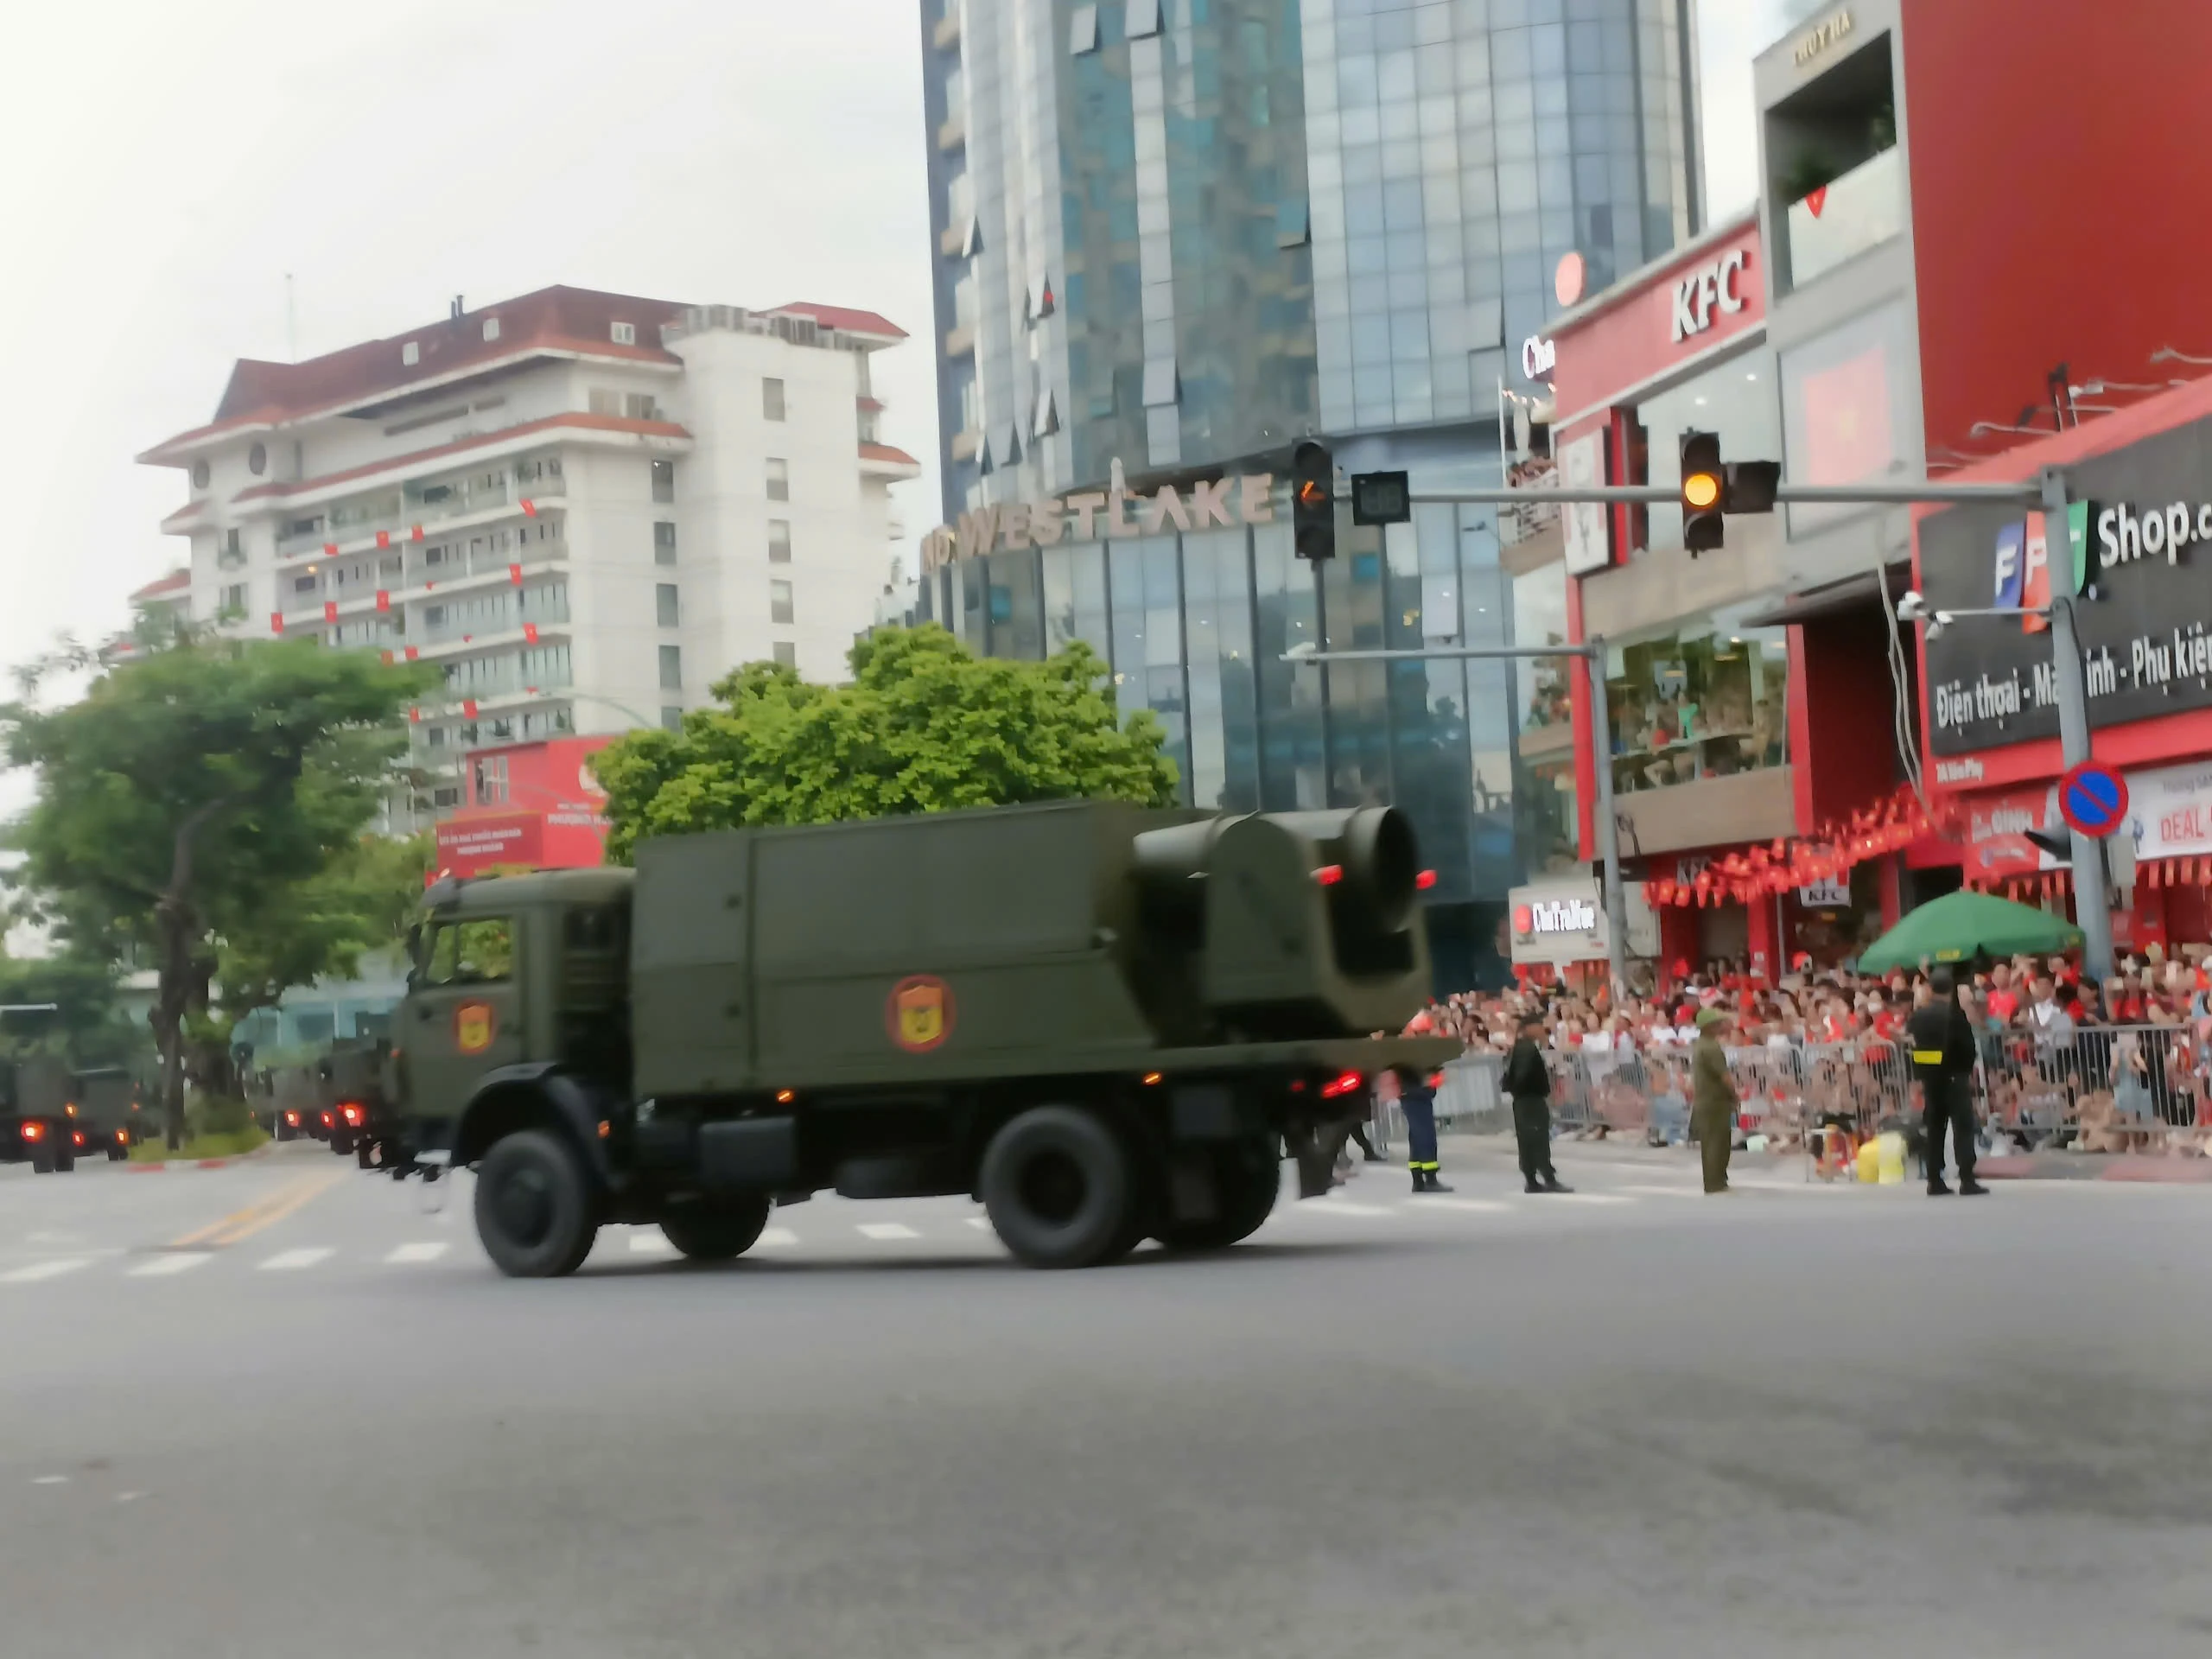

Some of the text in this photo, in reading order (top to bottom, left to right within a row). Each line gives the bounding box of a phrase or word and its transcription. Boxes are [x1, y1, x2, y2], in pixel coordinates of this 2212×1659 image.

[1671, 249, 1743, 342] KFC
[1975, 667, 2020, 730] thoại
[2132, 635, 2171, 696] Phụ
[2161, 807, 2205, 842] DEAL
